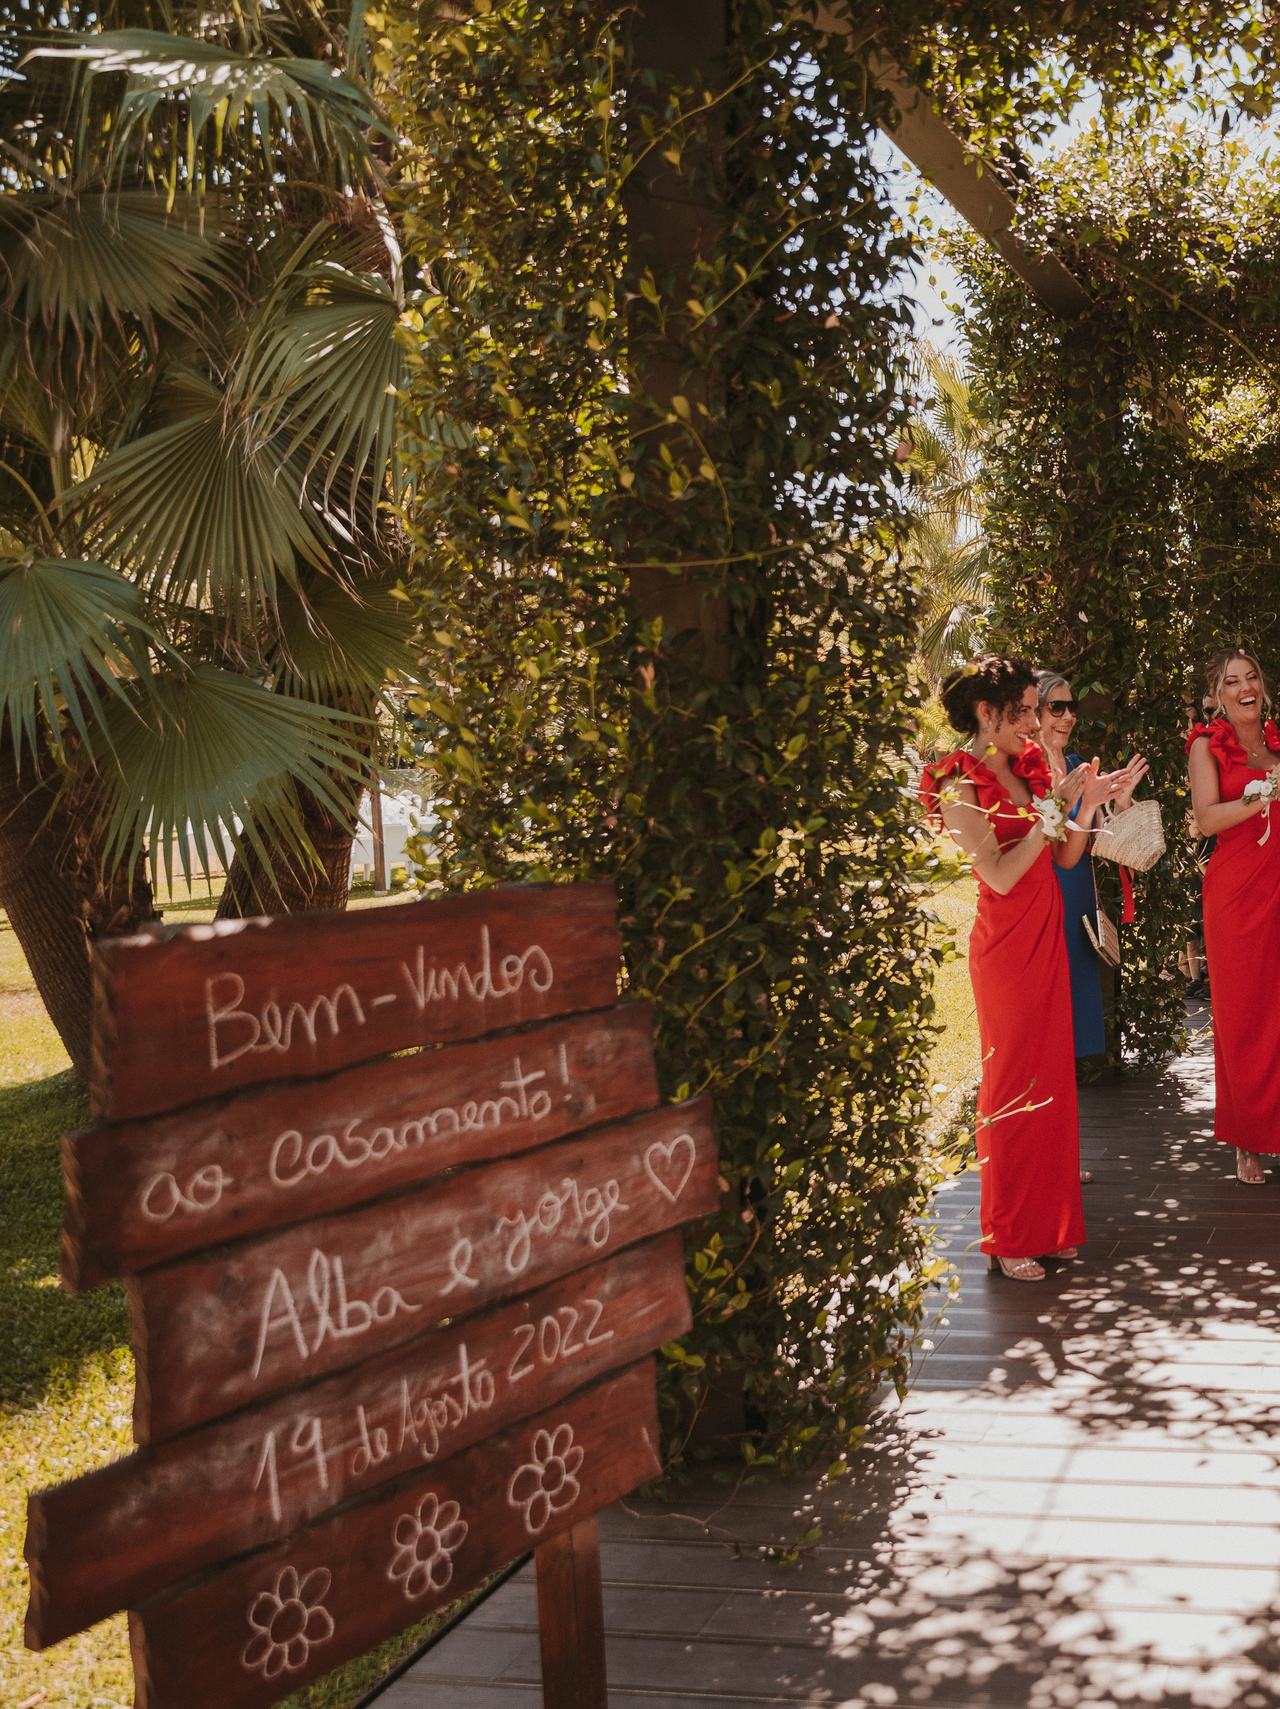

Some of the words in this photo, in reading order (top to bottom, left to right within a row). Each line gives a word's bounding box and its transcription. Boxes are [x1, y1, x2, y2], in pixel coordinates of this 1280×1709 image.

[139, 1164, 233, 1222] ao
[253, 1247, 423, 1381] Alba
[439, 1236, 479, 1296] e
[252, 1415, 329, 1523] 19
[352, 1404, 391, 1476] de
[506, 1298, 614, 1383] 2022
